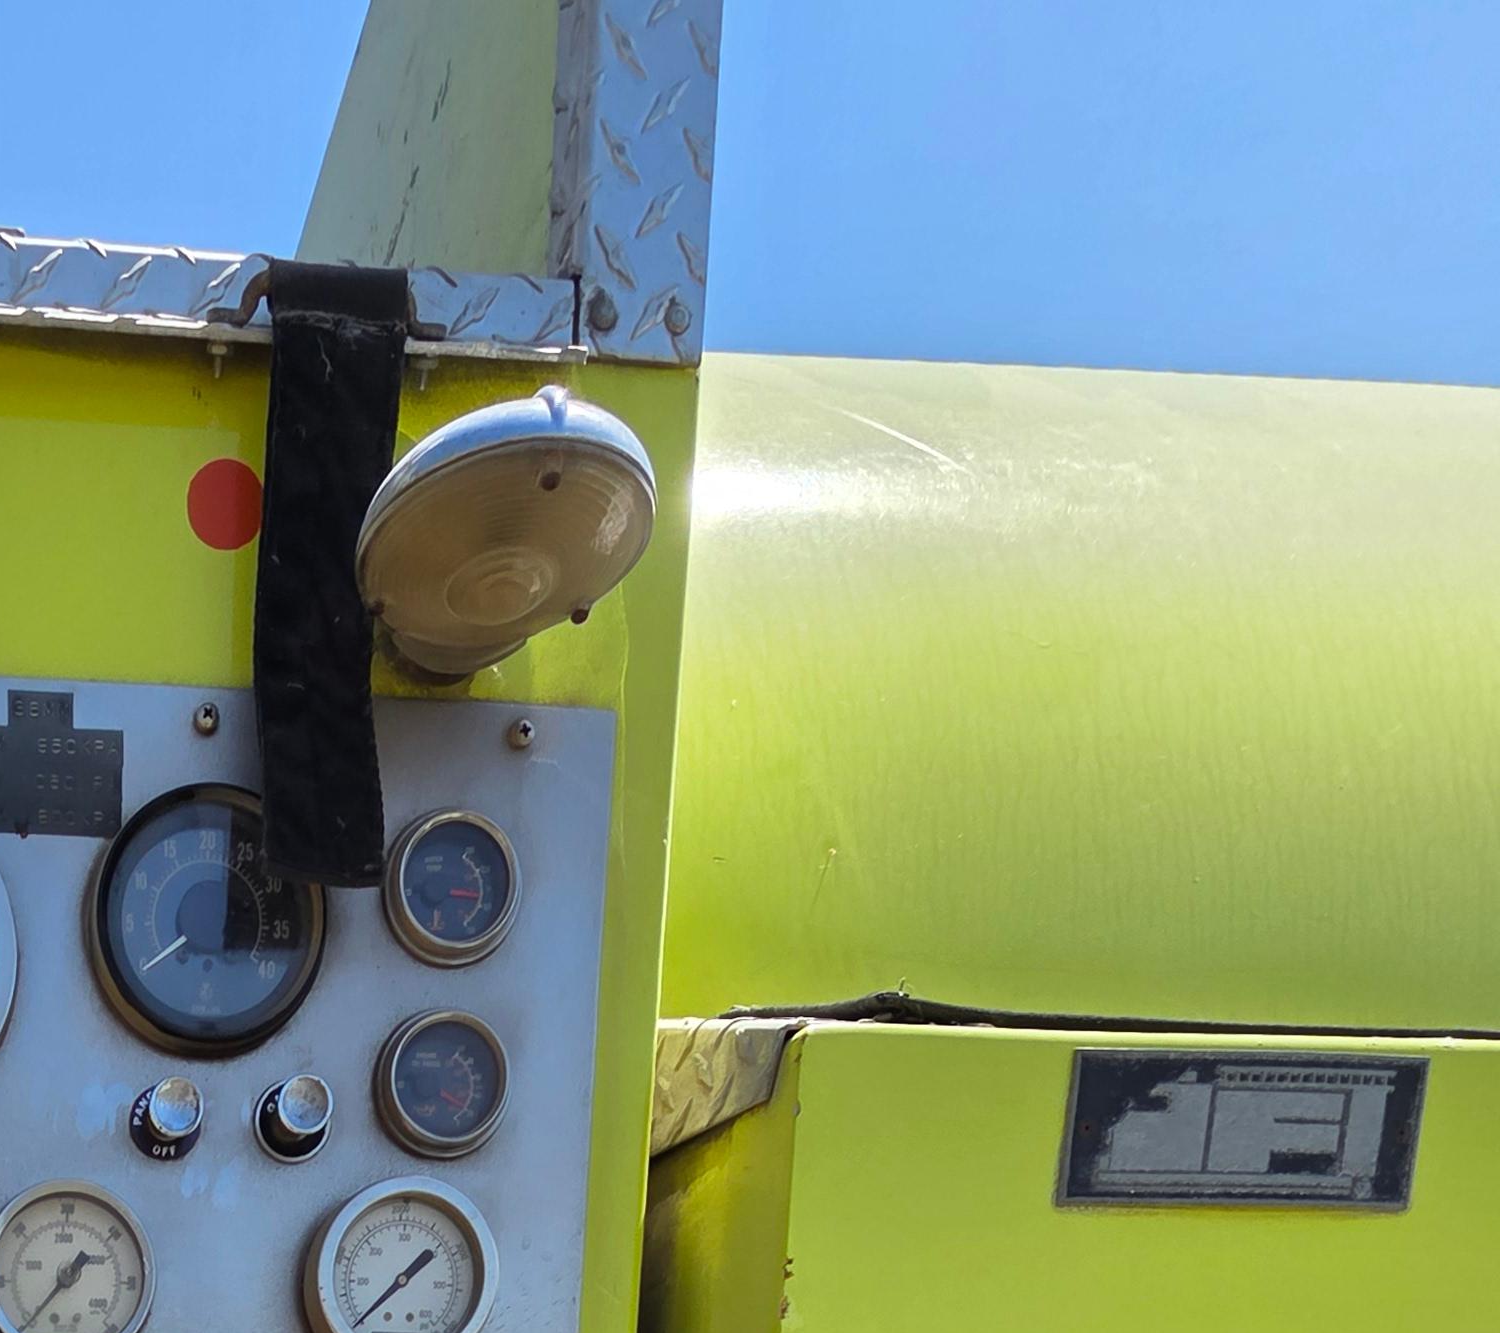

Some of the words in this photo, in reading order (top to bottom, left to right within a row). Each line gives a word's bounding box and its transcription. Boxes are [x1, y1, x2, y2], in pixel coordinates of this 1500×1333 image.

[199, 830, 216, 849] 20
[236, 841, 254, 862] 25
[265, 875, 283, 893] 30
[272, 919, 291, 939] 35
[257, 959, 277, 980] 40
[151, 1143, 177, 1158] OFF
